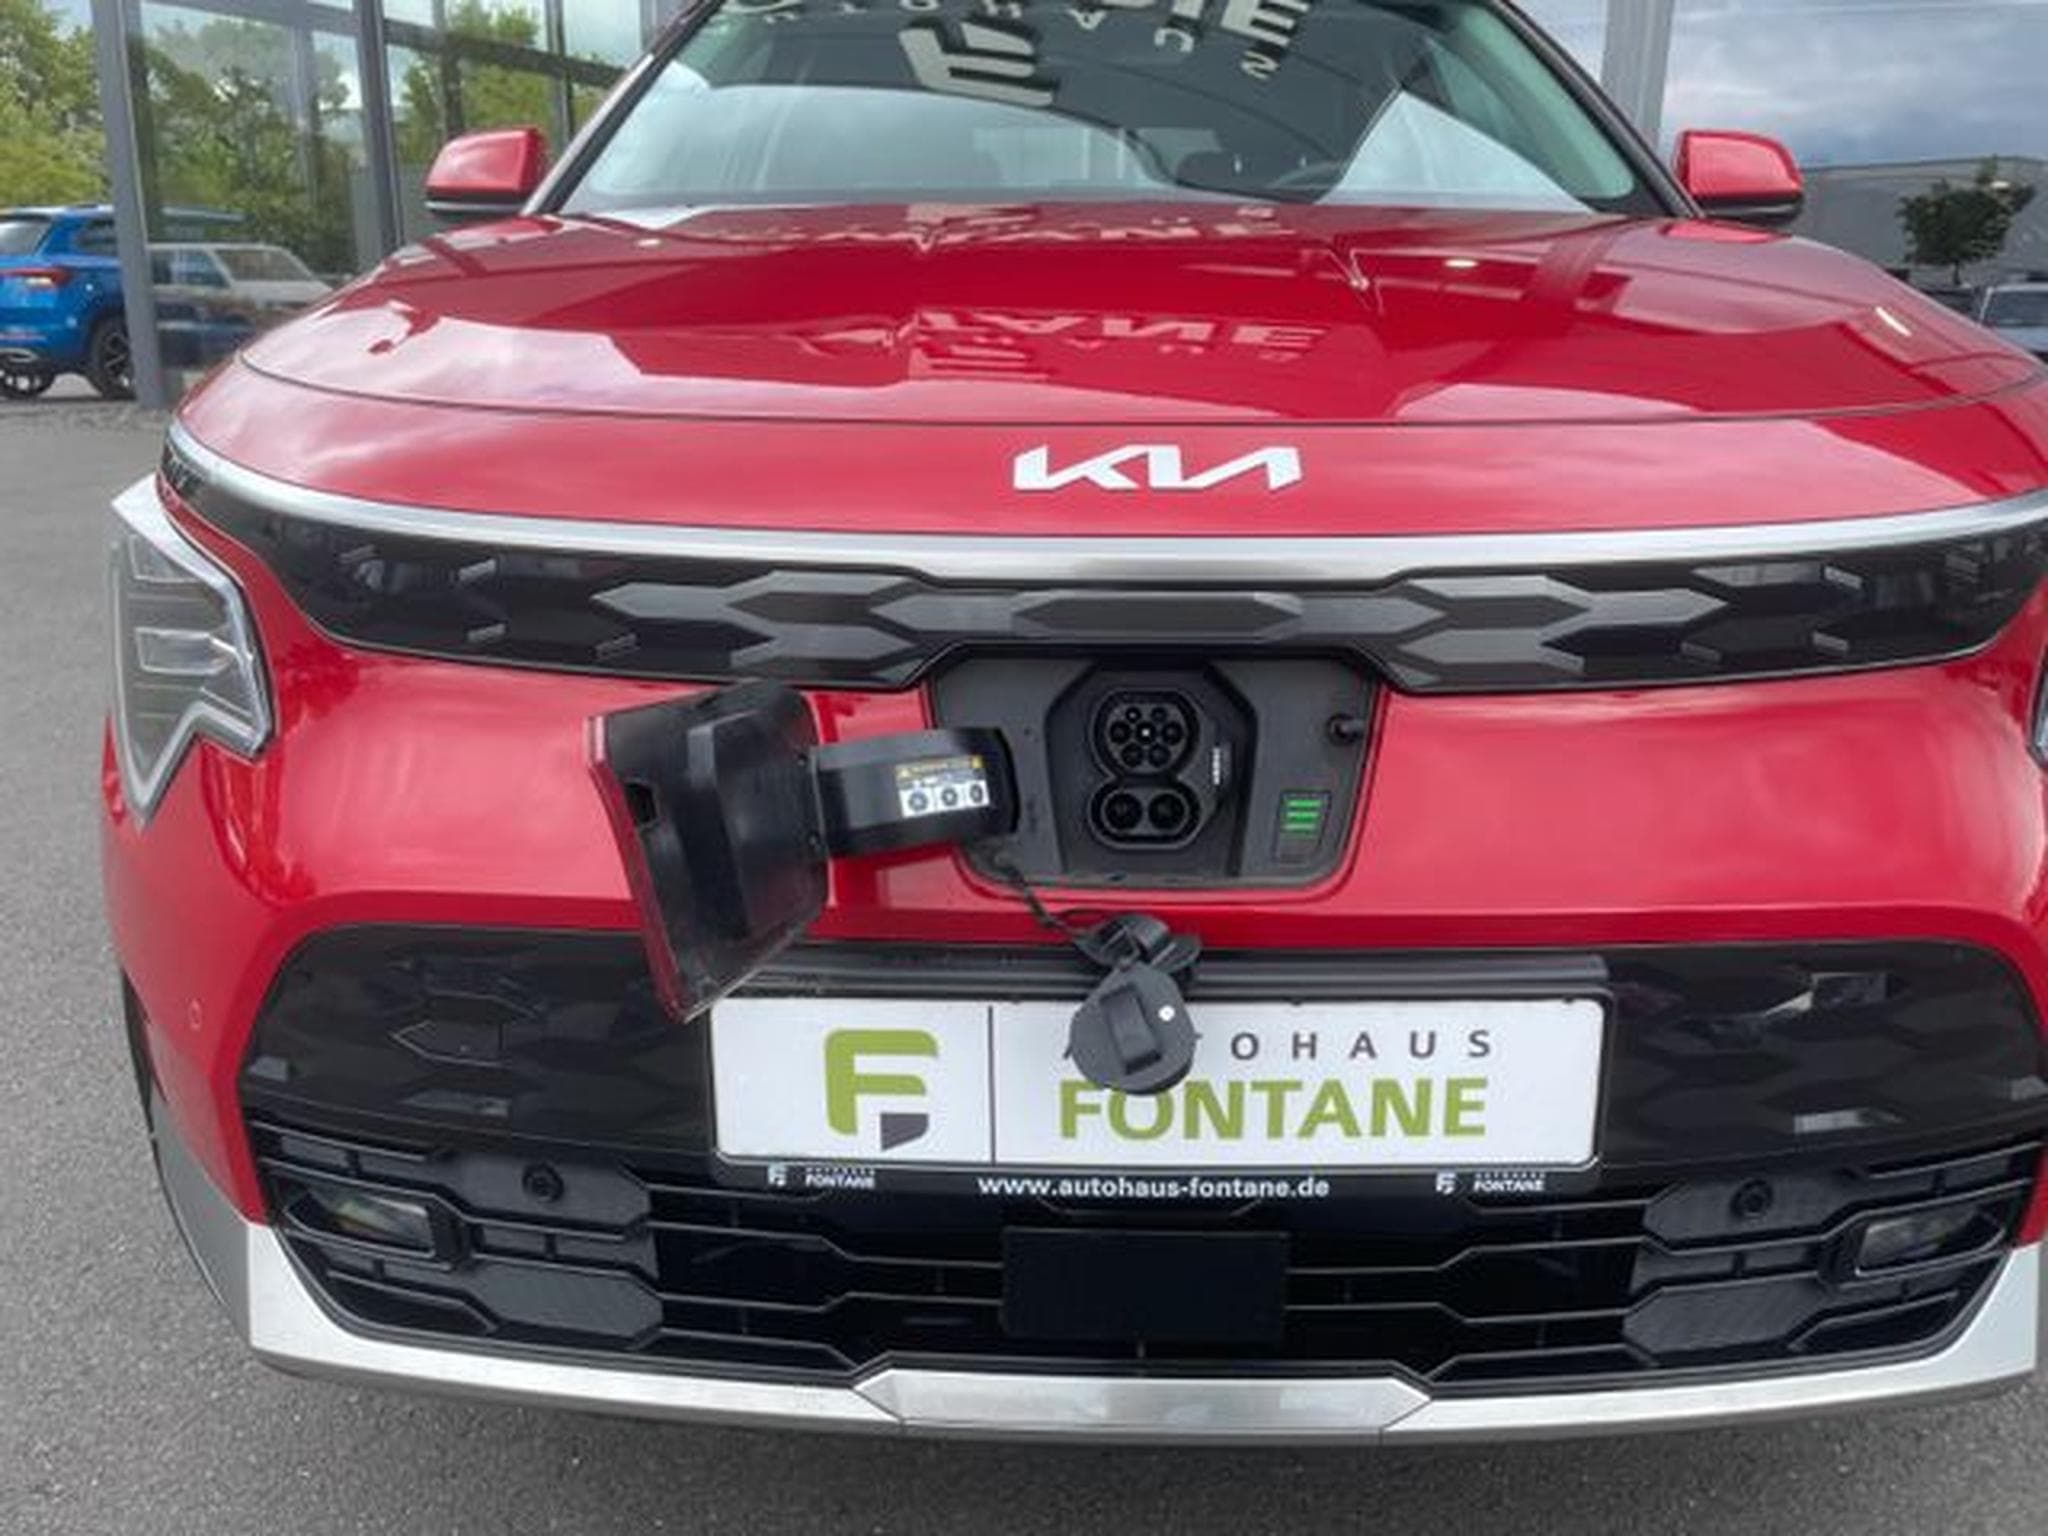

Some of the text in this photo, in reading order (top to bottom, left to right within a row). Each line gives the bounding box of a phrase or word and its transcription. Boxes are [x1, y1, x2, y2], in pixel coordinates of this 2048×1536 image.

[1013, 444, 1302, 491] KIA
[1063, 1030, 1491, 1060] OHAUS
[1059, 1078, 1488, 1140] FONTANE
[978, 1176, 1330, 1199] www.autohaus-fontane.de
